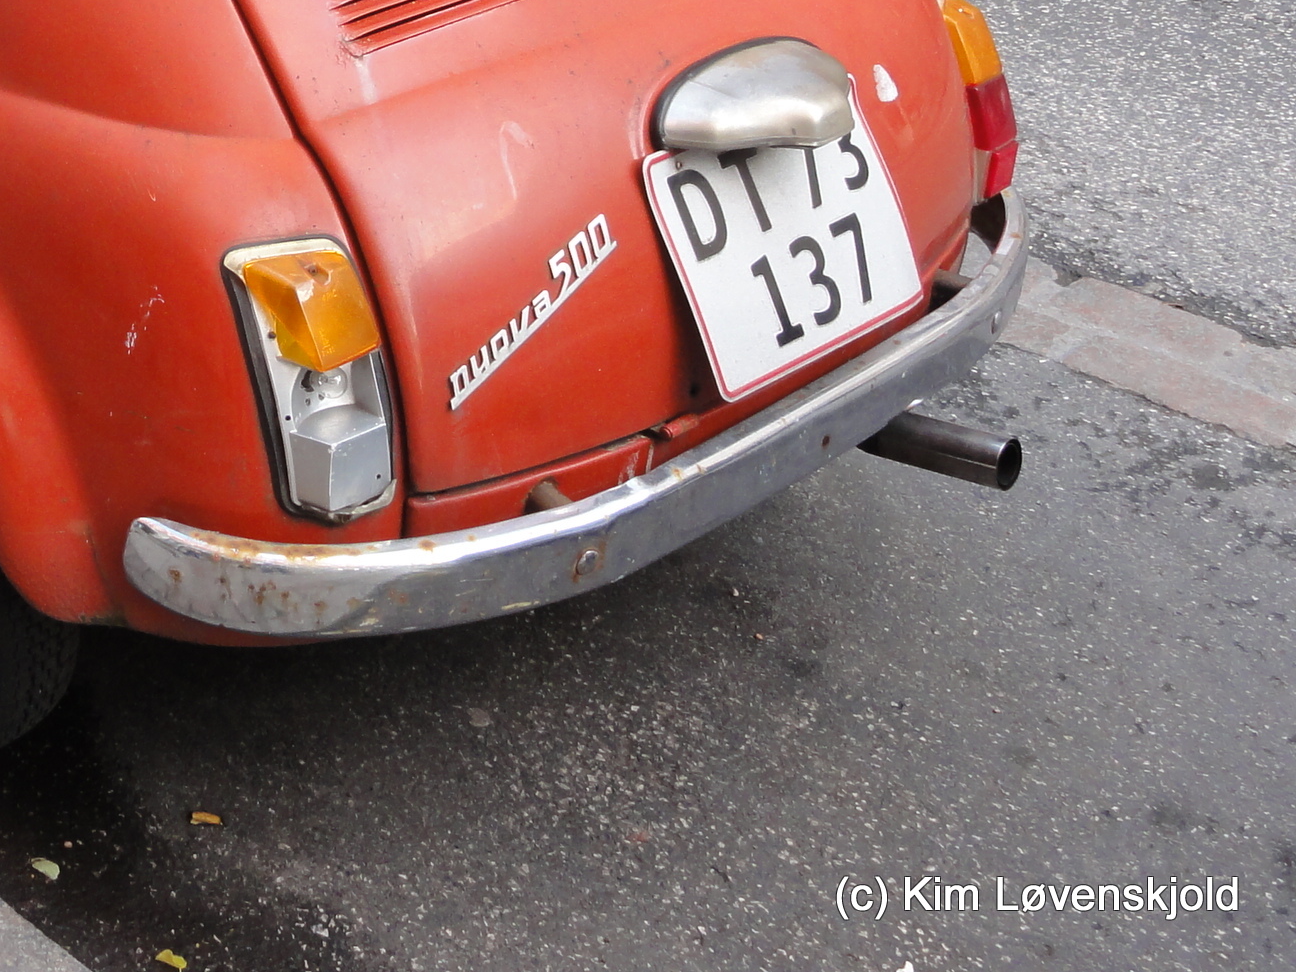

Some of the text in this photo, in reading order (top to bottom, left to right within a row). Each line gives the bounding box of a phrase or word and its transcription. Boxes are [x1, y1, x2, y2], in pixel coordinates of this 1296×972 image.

[667, 147, 773, 262] DT
[449, 214, 614, 401] nuova 500
[750, 212, 872, 348] 137
